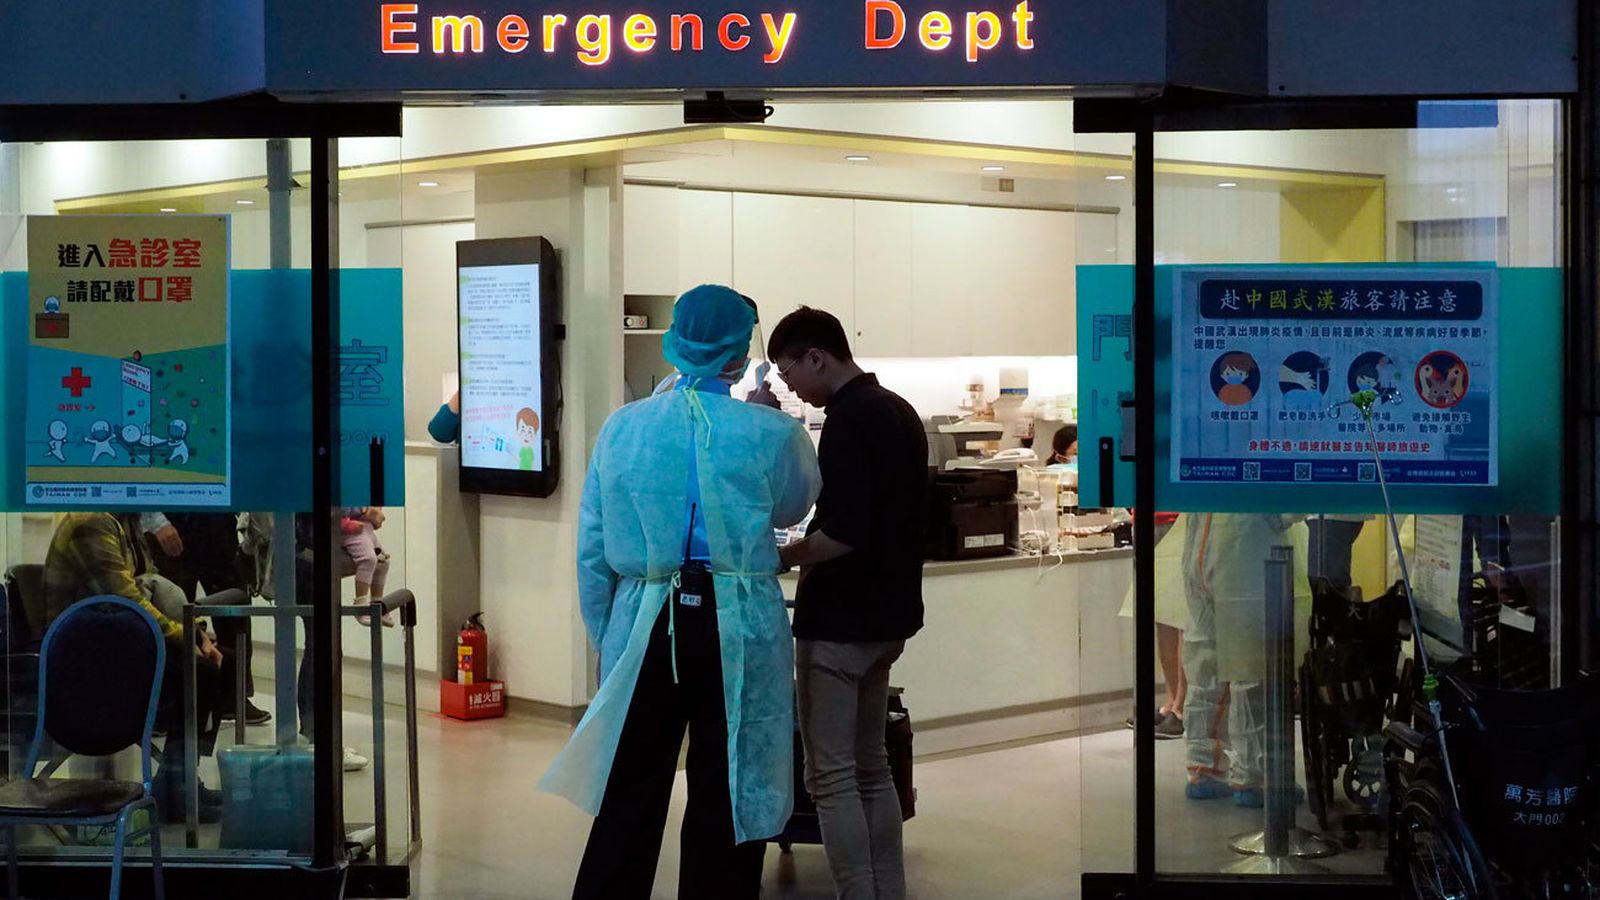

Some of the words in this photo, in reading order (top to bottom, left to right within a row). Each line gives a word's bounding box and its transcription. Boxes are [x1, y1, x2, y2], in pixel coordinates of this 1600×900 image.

[380, 2, 797, 65] Emergency
[864, 0, 1035, 62] Dept
[57, 238, 202, 268] 進入急診室
[66, 276, 193, 303] 請配戴口罩
[1219, 288, 1458, 313] 赴中國武漢旅客請注意
[1338, 422, 1407, 433] 醫院等多場所
[1504, 783, 1578, 806] 萬芳醫院
